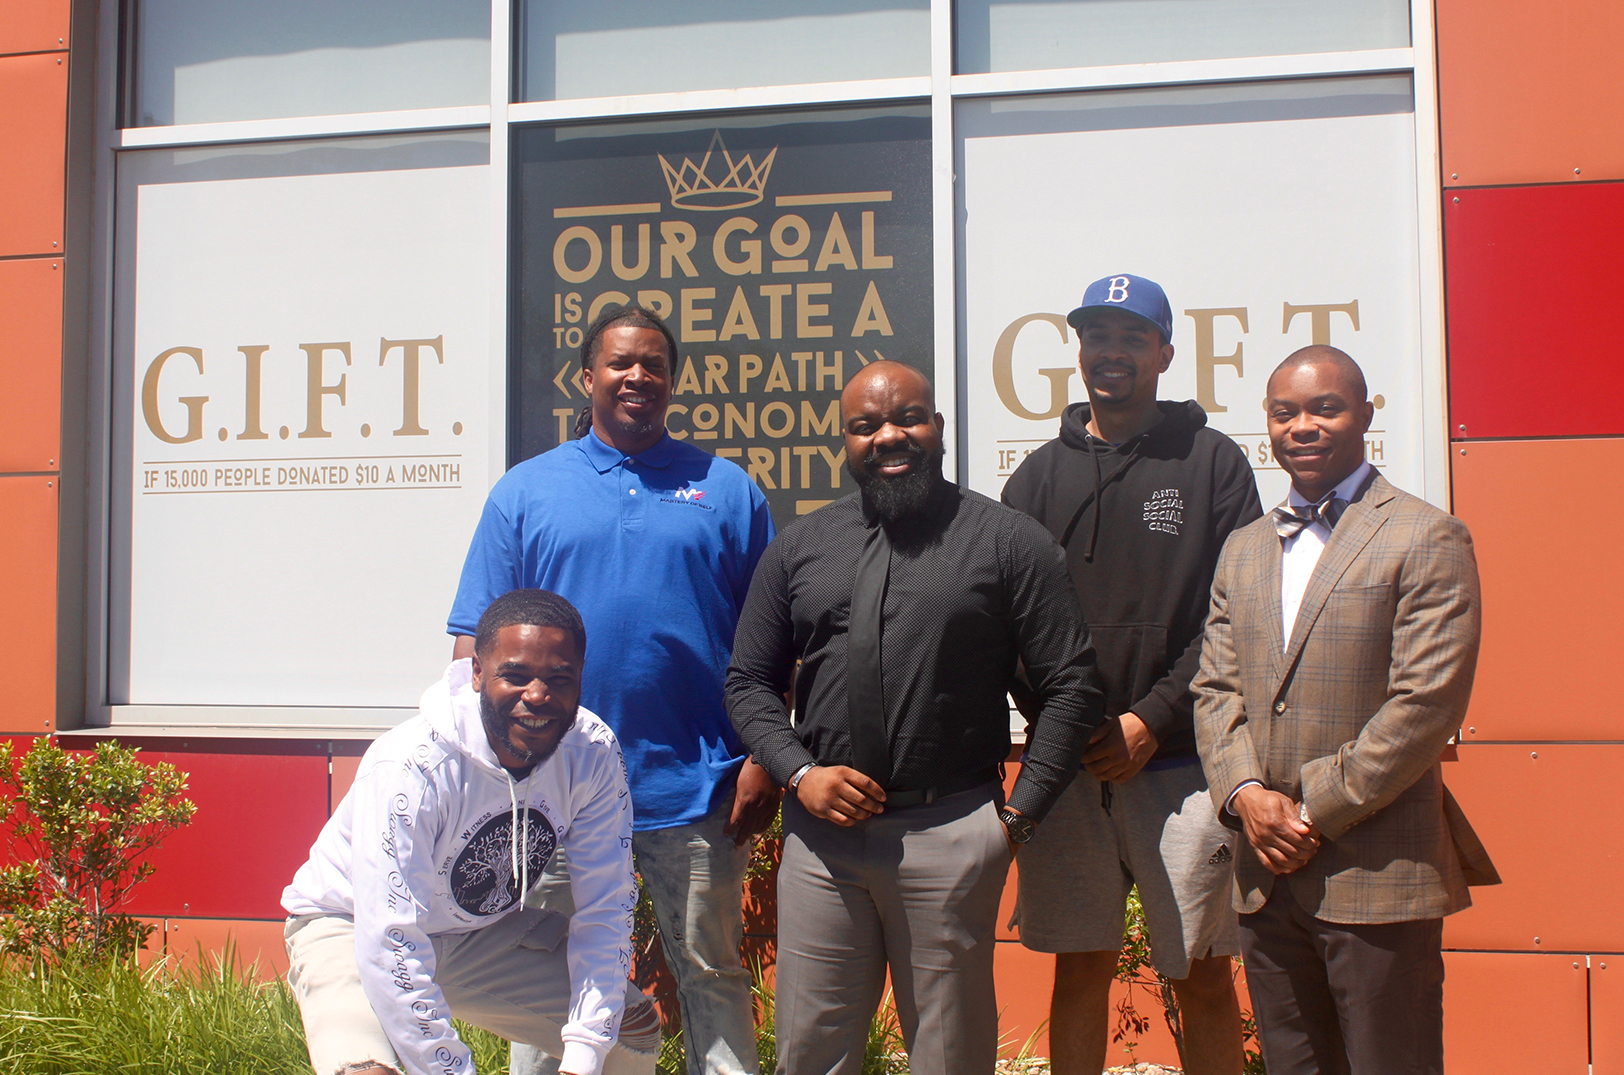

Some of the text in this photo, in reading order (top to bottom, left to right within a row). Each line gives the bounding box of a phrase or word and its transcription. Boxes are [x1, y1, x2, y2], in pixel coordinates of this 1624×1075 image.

[553, 211, 893, 283] OUR GOAL
[1104, 276, 1130, 303] B
[555, 292, 583, 323] IS
[850, 280, 893, 337] A
[552, 327, 583, 349] TO
[739, 350, 843, 393] PATH
[141, 334, 463, 444] G.I.F.T.
[998, 450, 1017, 470] IF
[144, 463, 460, 489] IF 15,000 PEOPLE DONATED $10 A MONTH
[1143, 499, 1184, 510] SOCIAL
[1152, 489, 1179, 499] ANTI
[1143, 510, 1183, 524] SOCIAL
